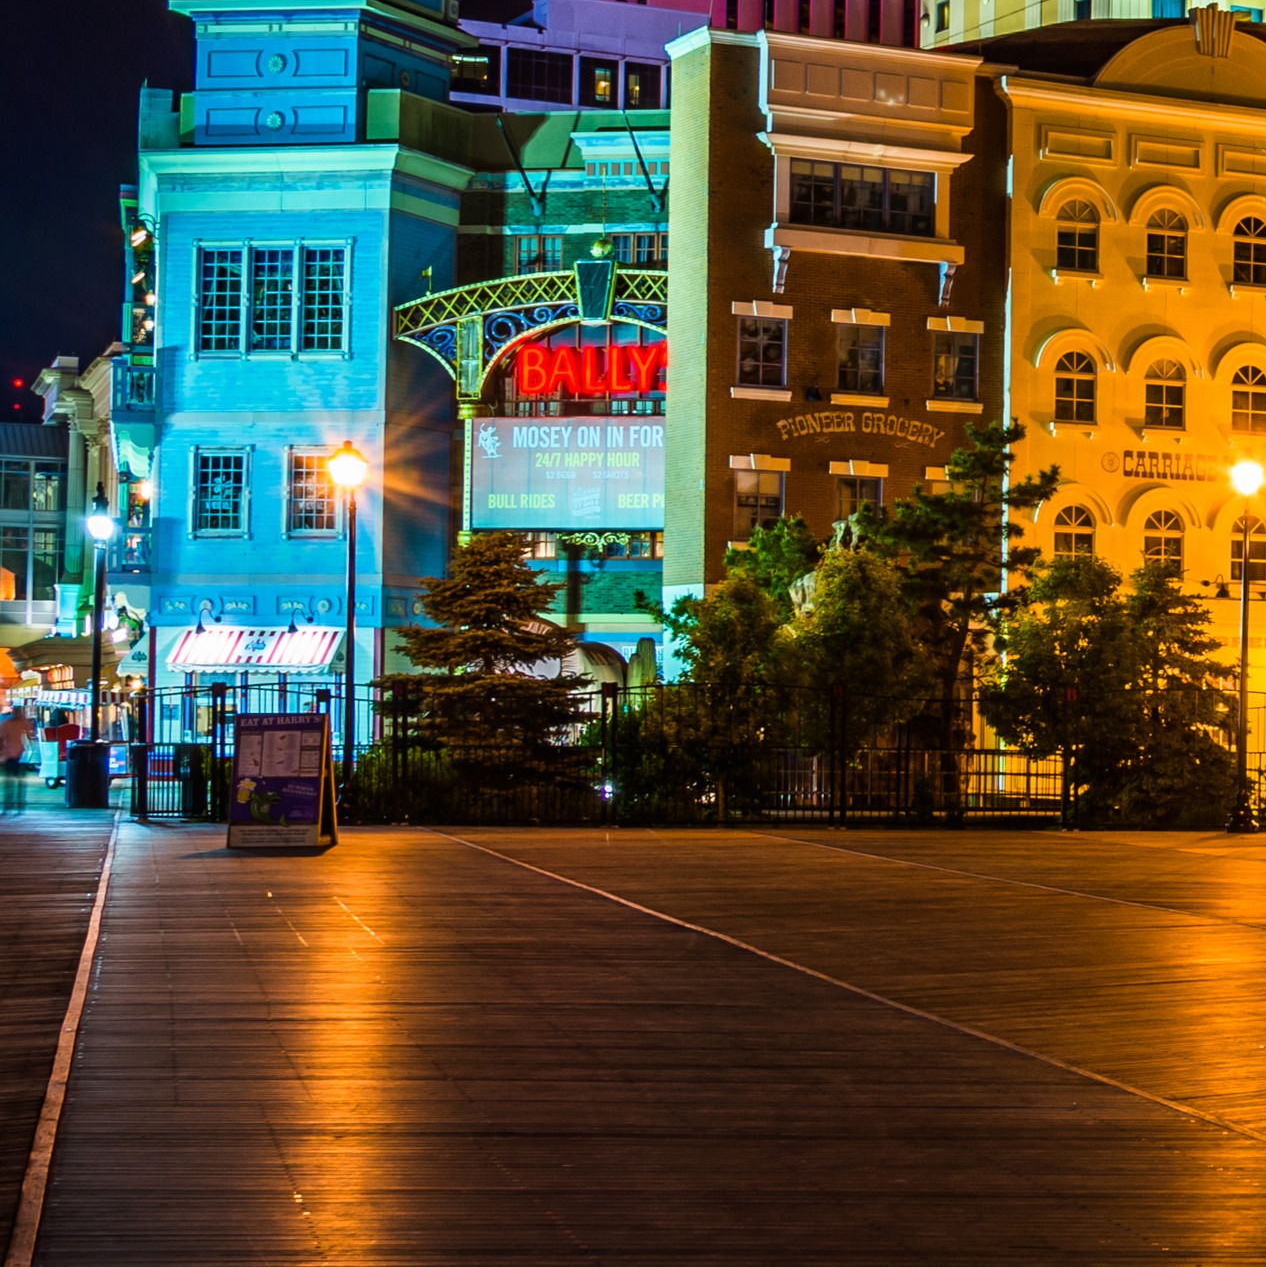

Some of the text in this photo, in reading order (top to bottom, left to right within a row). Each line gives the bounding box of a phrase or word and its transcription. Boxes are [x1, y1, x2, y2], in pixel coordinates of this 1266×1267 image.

[512, 425, 664, 448] MOSEY ON IN FOR
[776, 411, 946, 448] PIONEER GROCERY
[535, 452, 640, 468] 24/7 HAPPY HOUR
[1123, 449, 1218, 482] CARRIAGE
[555, 471, 576, 479] BEER
[603, 471, 629, 479] SHOTS
[488, 494, 555, 509] BULL RIDES
[618, 494, 648, 509] BEER
[240, 718, 260, 727] EAT
[262, 717, 275, 726] AT
